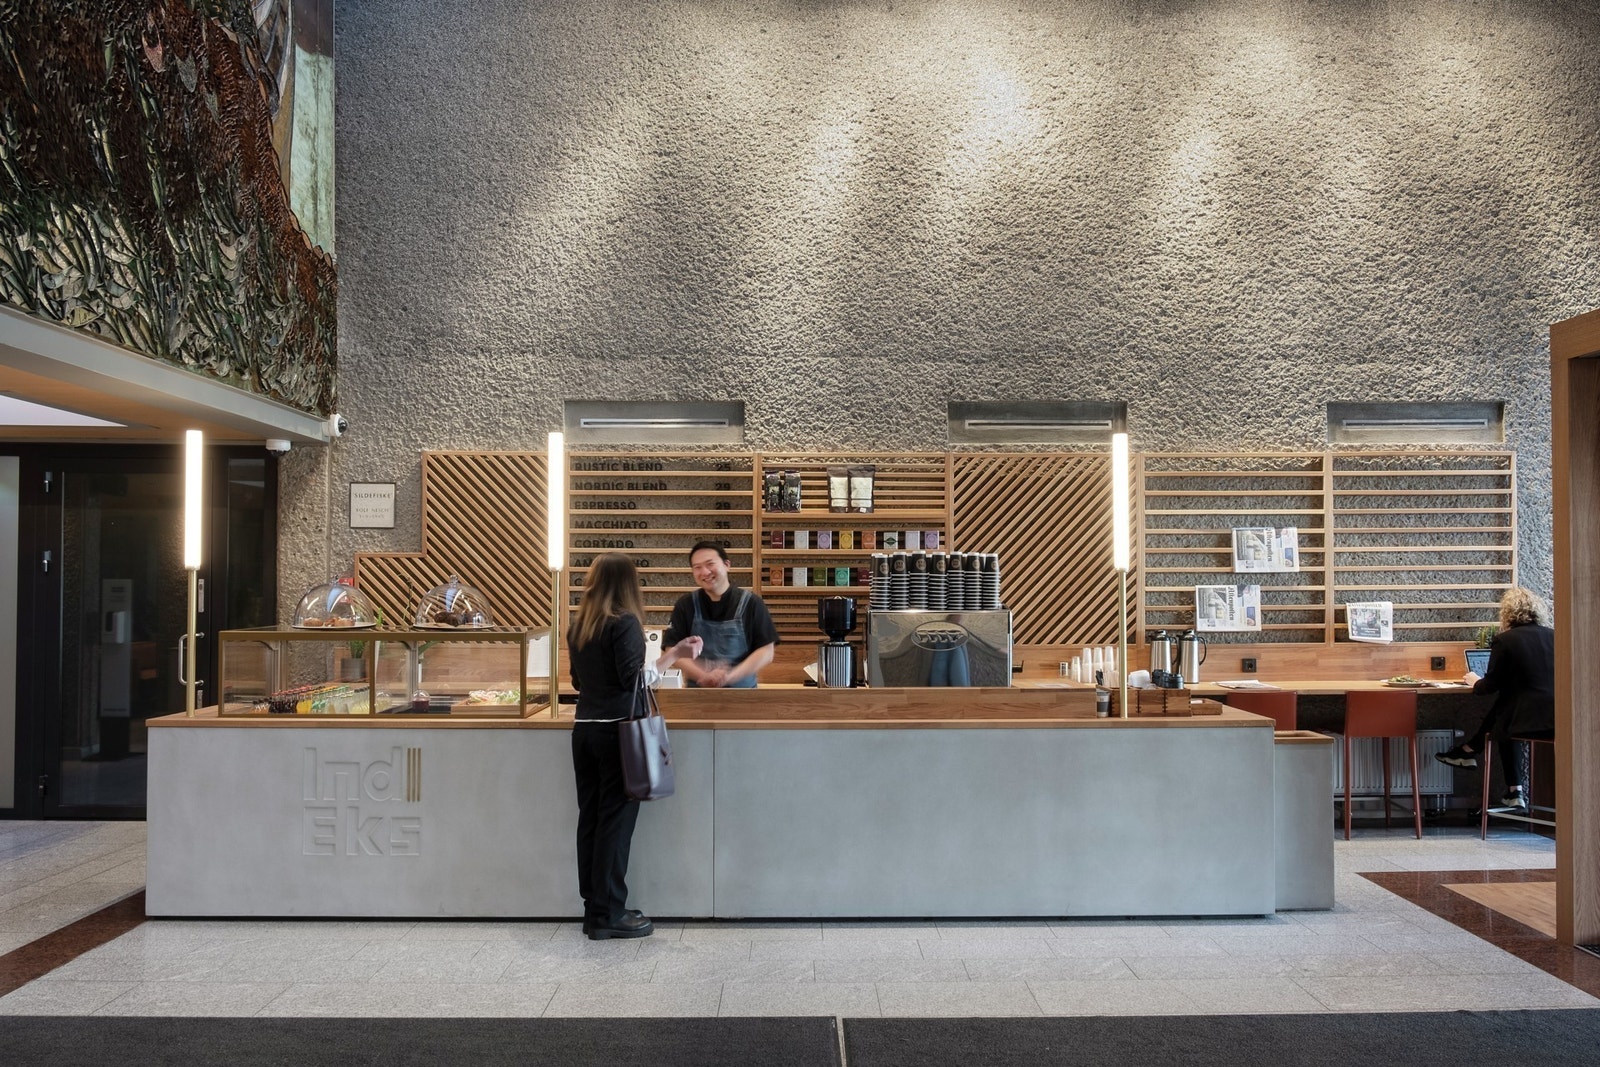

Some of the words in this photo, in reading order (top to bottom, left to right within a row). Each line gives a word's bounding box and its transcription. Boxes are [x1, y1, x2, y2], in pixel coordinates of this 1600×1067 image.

[575, 462, 619, 471] RUSTIC
[622, 462, 663, 471] BLEND
[575, 482, 624, 490] NORDIC
[627, 482, 667, 490] BLEND
[575, 501, 637, 510] ESPRESSO
[574, 520, 648, 529] MACCHIATO
[575, 539, 634, 548] CORTADO
